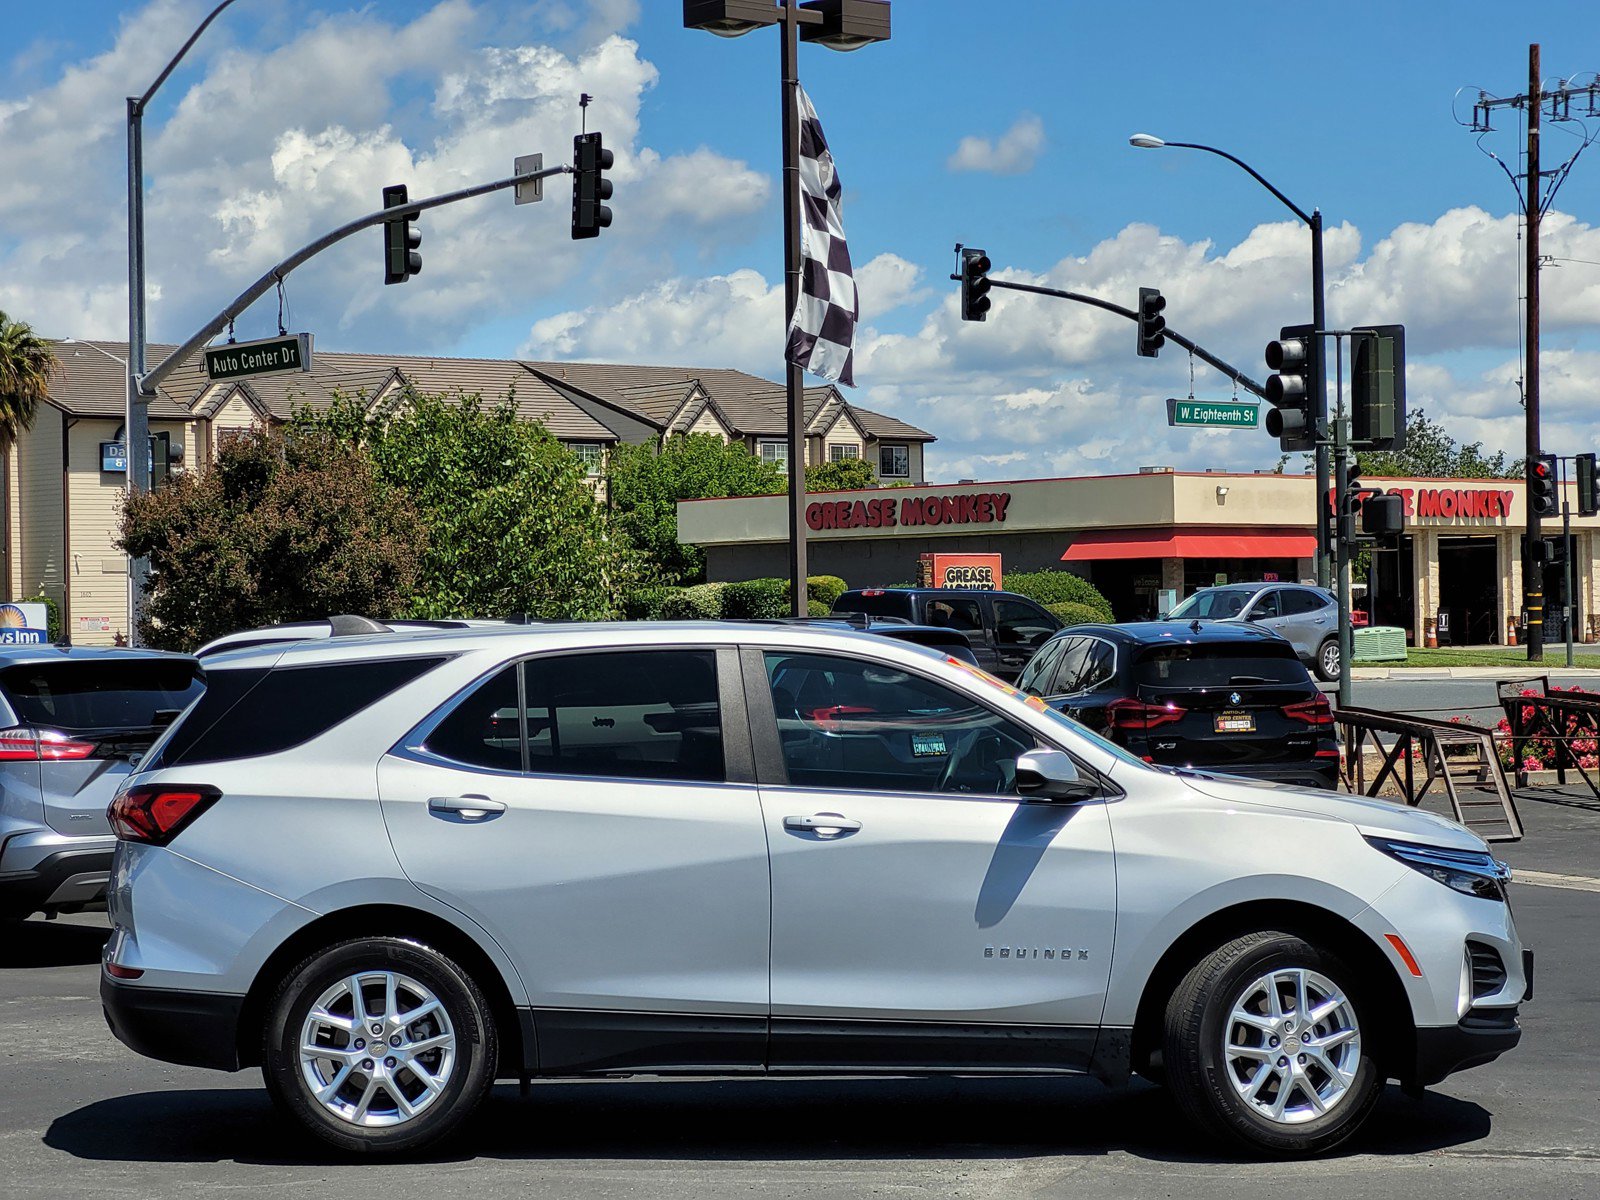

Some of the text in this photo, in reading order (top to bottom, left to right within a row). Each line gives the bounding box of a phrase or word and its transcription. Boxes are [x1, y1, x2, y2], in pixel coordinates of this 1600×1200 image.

[213, 347, 295, 373] Auto Center Dr
[1181, 407, 1254, 423] W. Eighteenth St
[1417, 488, 1515, 518] MONKEY
[805, 492, 1011, 531] GREASE MONKEY
[946, 568, 992, 583] GREASE
[1263, 573, 1279, 581] OPEN
[15, 630, 40, 644] Inn
[983, 946, 1089, 961] EQUINOX
